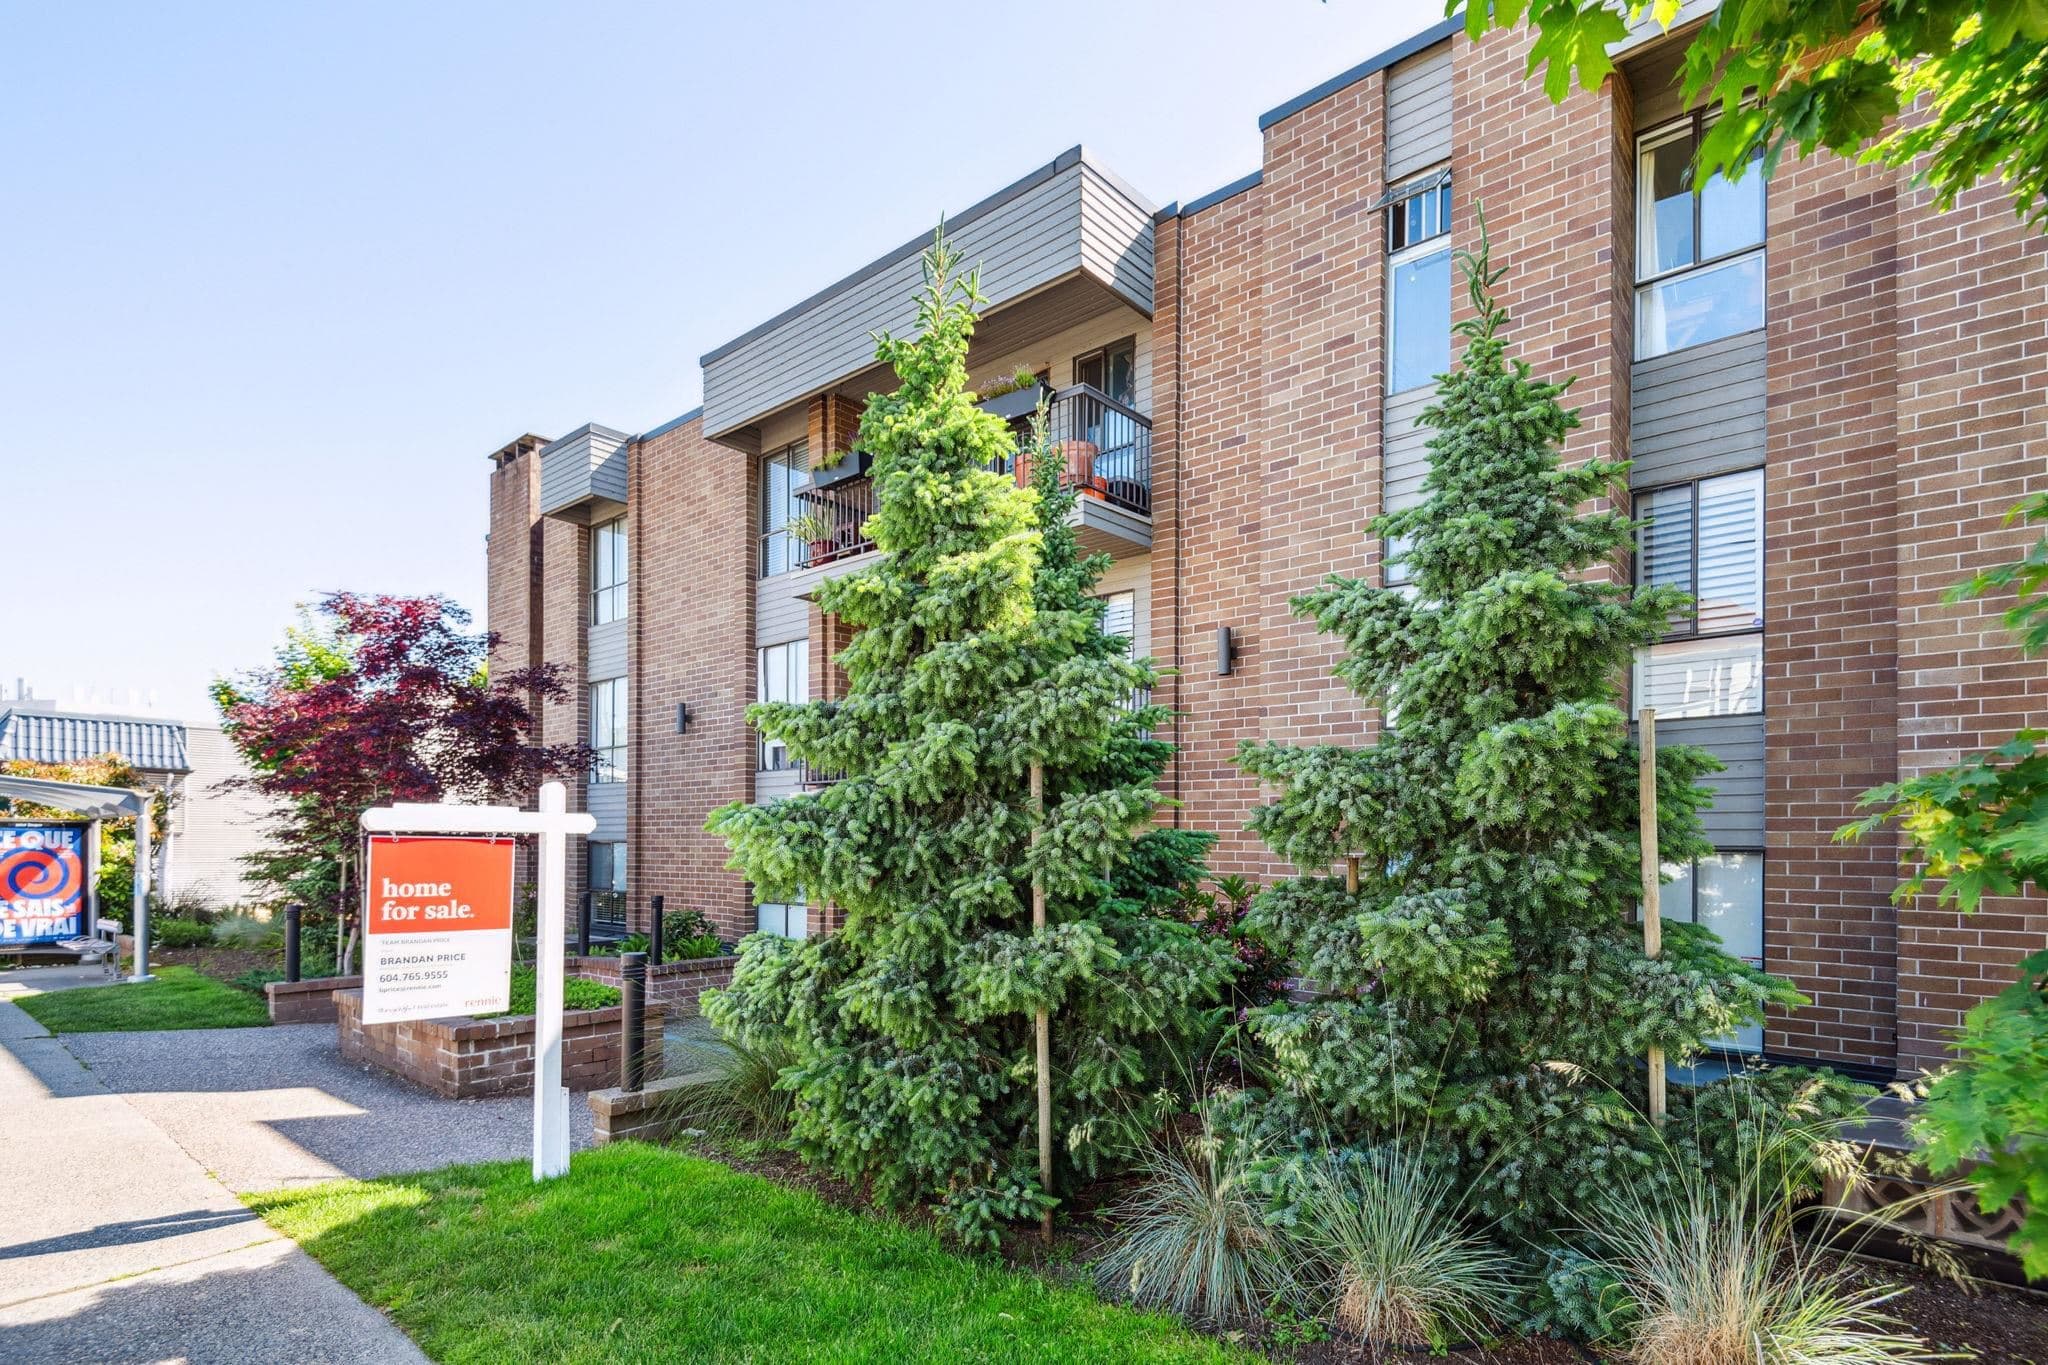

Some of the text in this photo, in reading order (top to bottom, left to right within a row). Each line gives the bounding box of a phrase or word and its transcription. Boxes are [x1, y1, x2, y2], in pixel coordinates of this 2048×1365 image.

[0, 830, 73, 850] E QUE
[382, 877, 452, 898] home
[13, 898, 64, 918] SAIS
[381, 899, 475, 921] for sale.
[20, 916, 77, 937] VRAI
[380, 953, 466, 965] BRANDAN PRICE
[379, 970, 449, 983] 604.765.9555
[465, 996, 502, 1008] rennie
